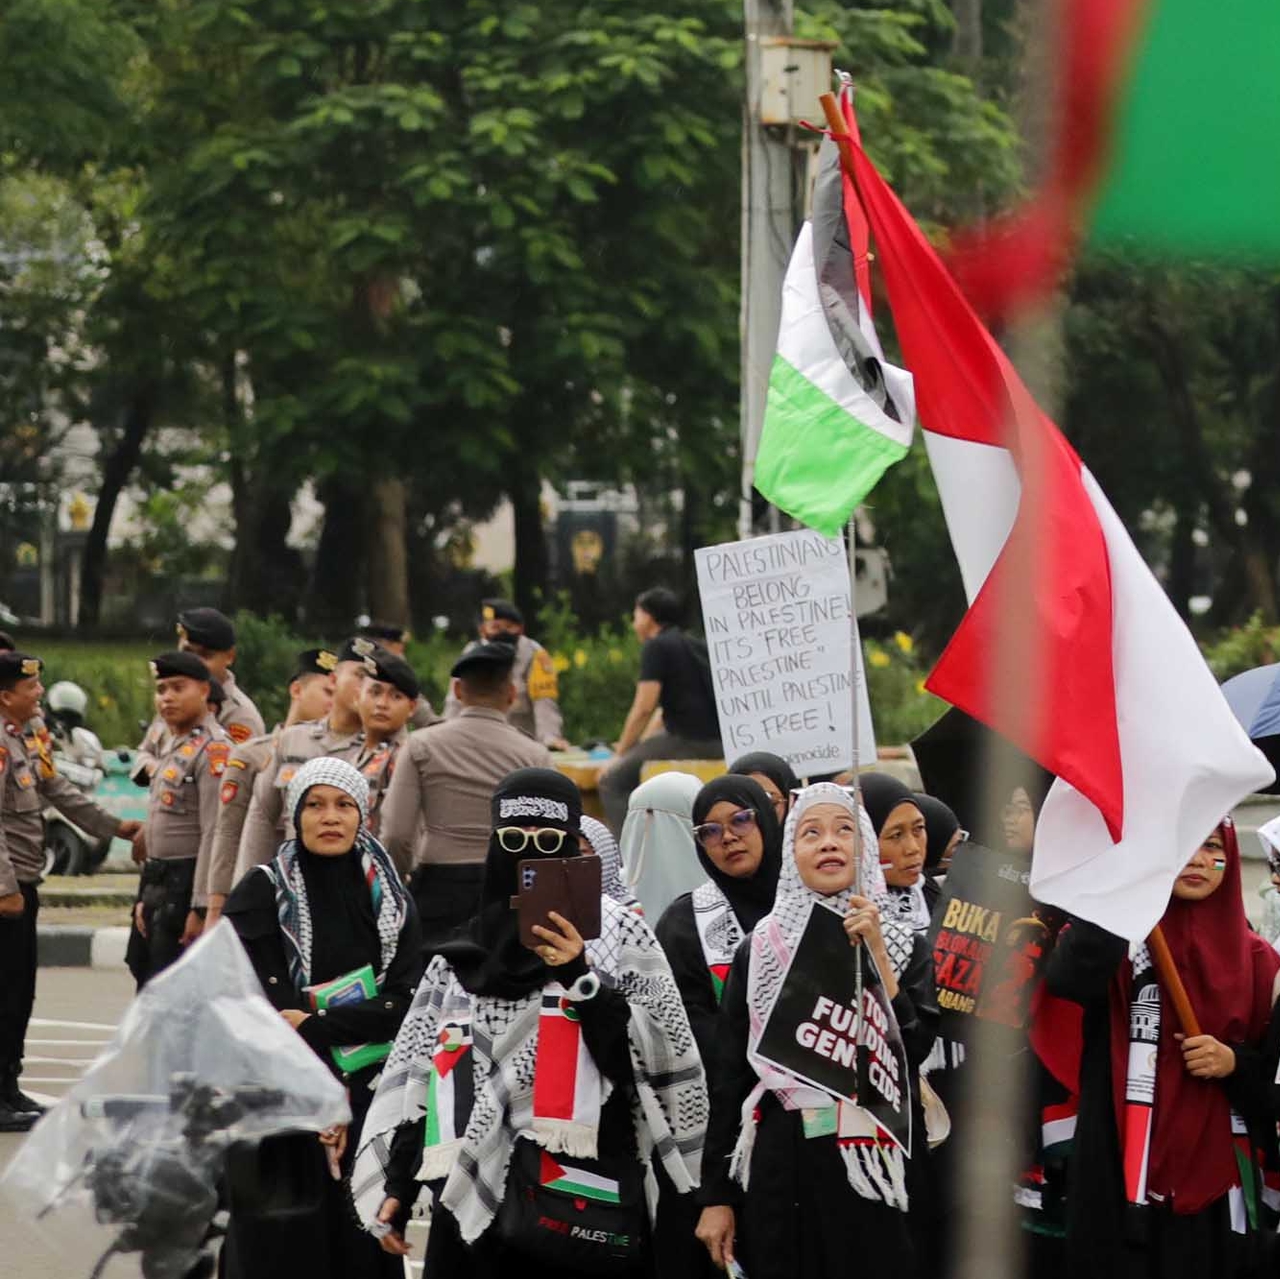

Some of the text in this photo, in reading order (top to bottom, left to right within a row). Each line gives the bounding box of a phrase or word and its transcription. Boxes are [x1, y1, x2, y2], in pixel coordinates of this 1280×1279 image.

[706, 537, 841, 581] PALESTINIANS
[732, 576, 810, 610] BELONG
[709, 616, 729, 633] IN
[720, 690, 775, 717] UNTIL
[729, 723, 755, 749] IS
[942, 897, 1001, 943] BUKA
[933, 950, 983, 997] AZA
[796, 1022, 901, 1113] GENCIDE
